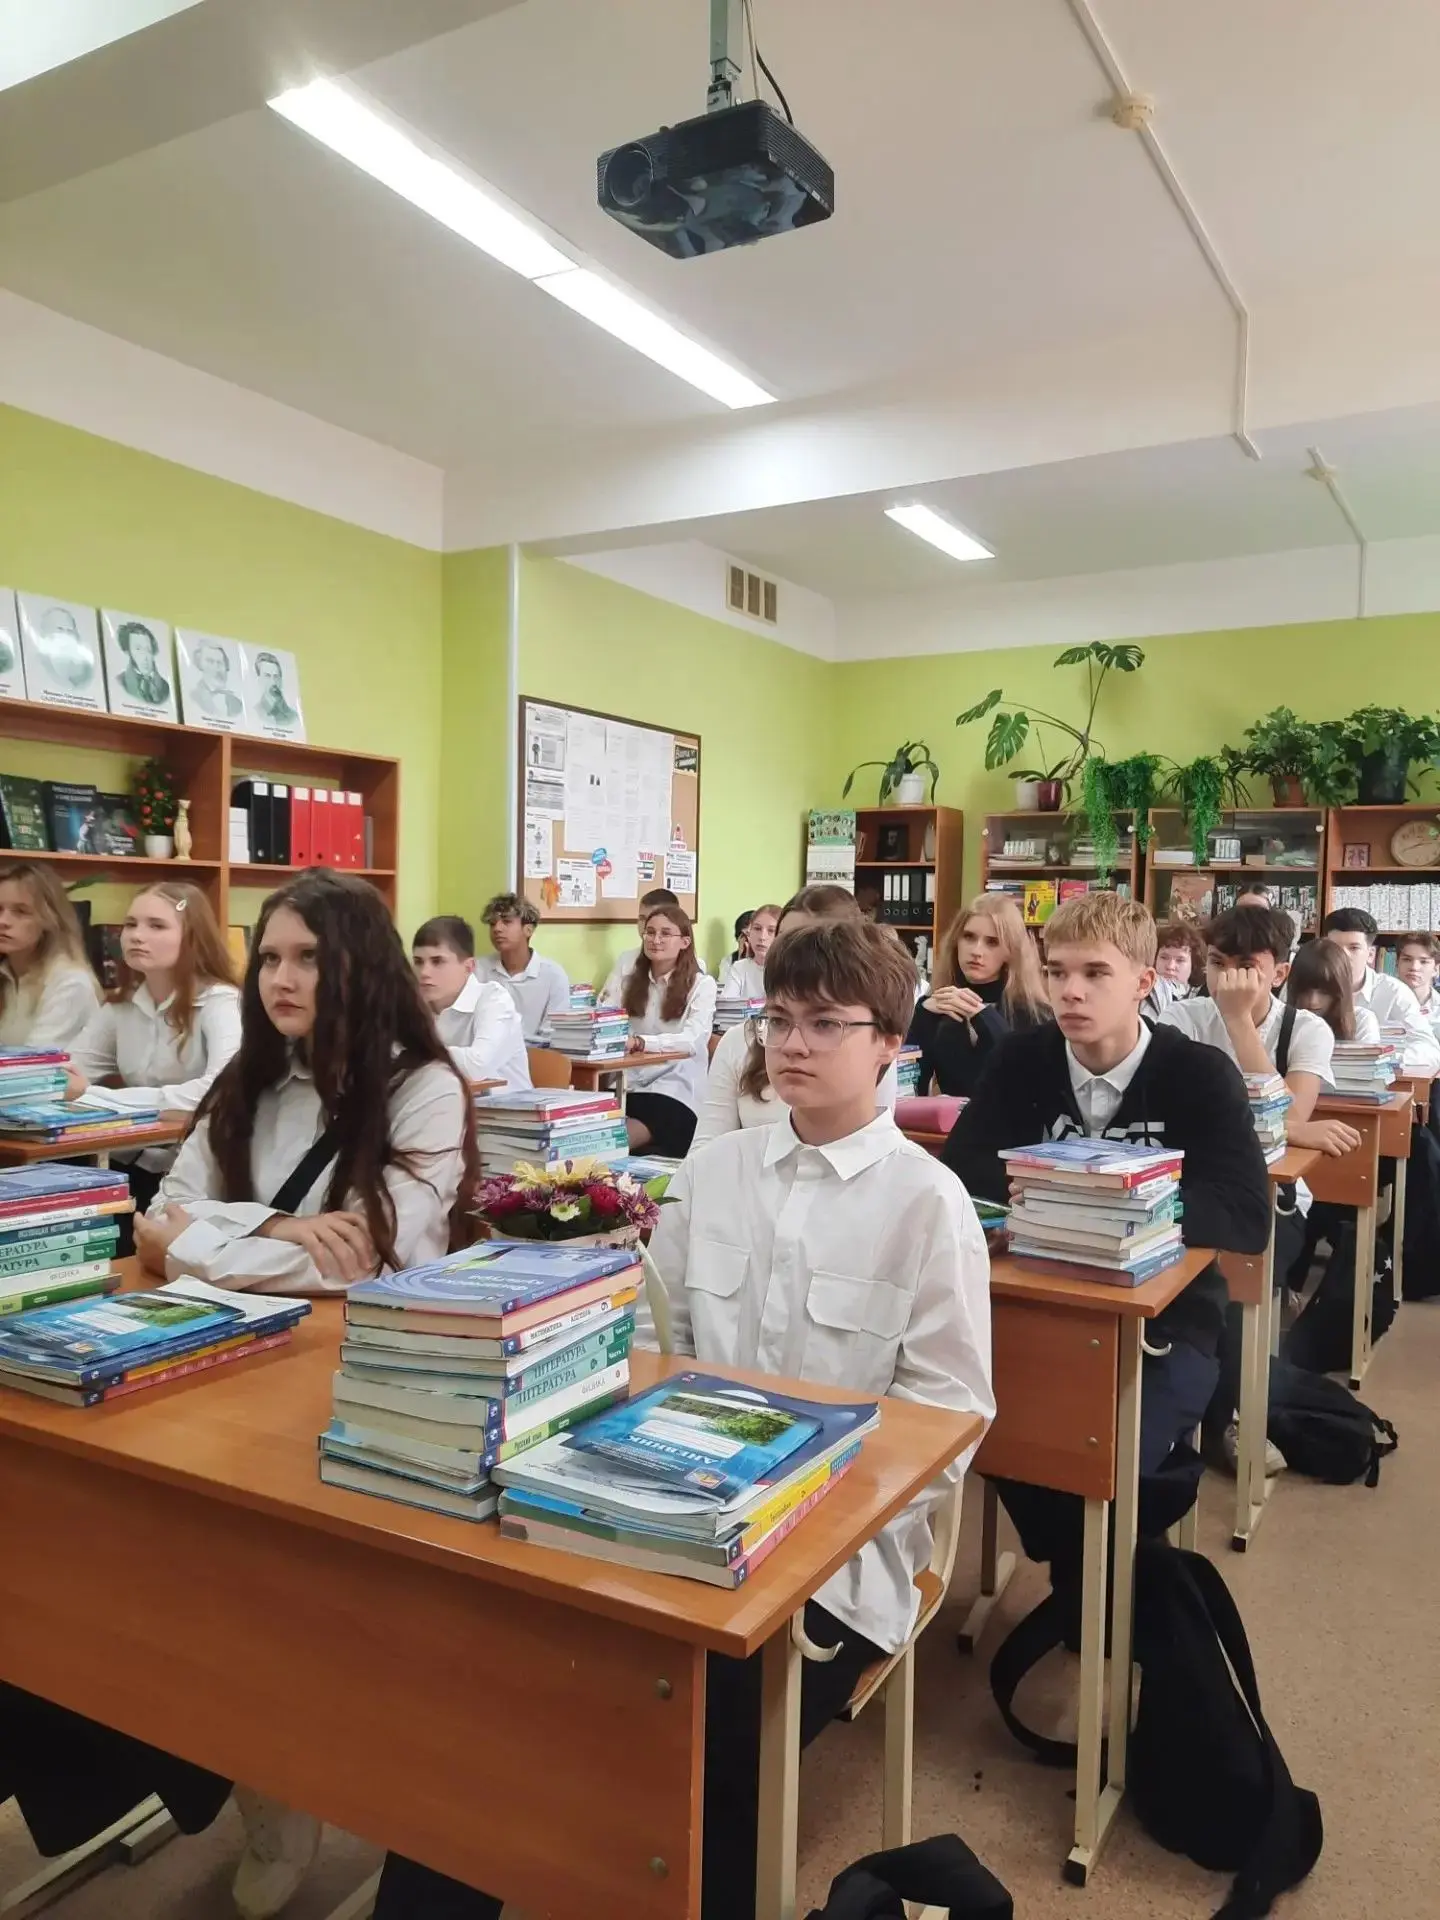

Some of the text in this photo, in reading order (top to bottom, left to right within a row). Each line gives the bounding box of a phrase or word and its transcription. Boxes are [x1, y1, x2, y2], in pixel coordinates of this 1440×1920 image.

[534, 1344, 587, 1379] ЛИТЕРАТУРА
[515, 1371, 577, 1406] ЛИТЕРАТУРА
[581, 1377, 607, 1395] ФИЗИКА
[628, 1435, 720, 1465] ДНЕВНИК
